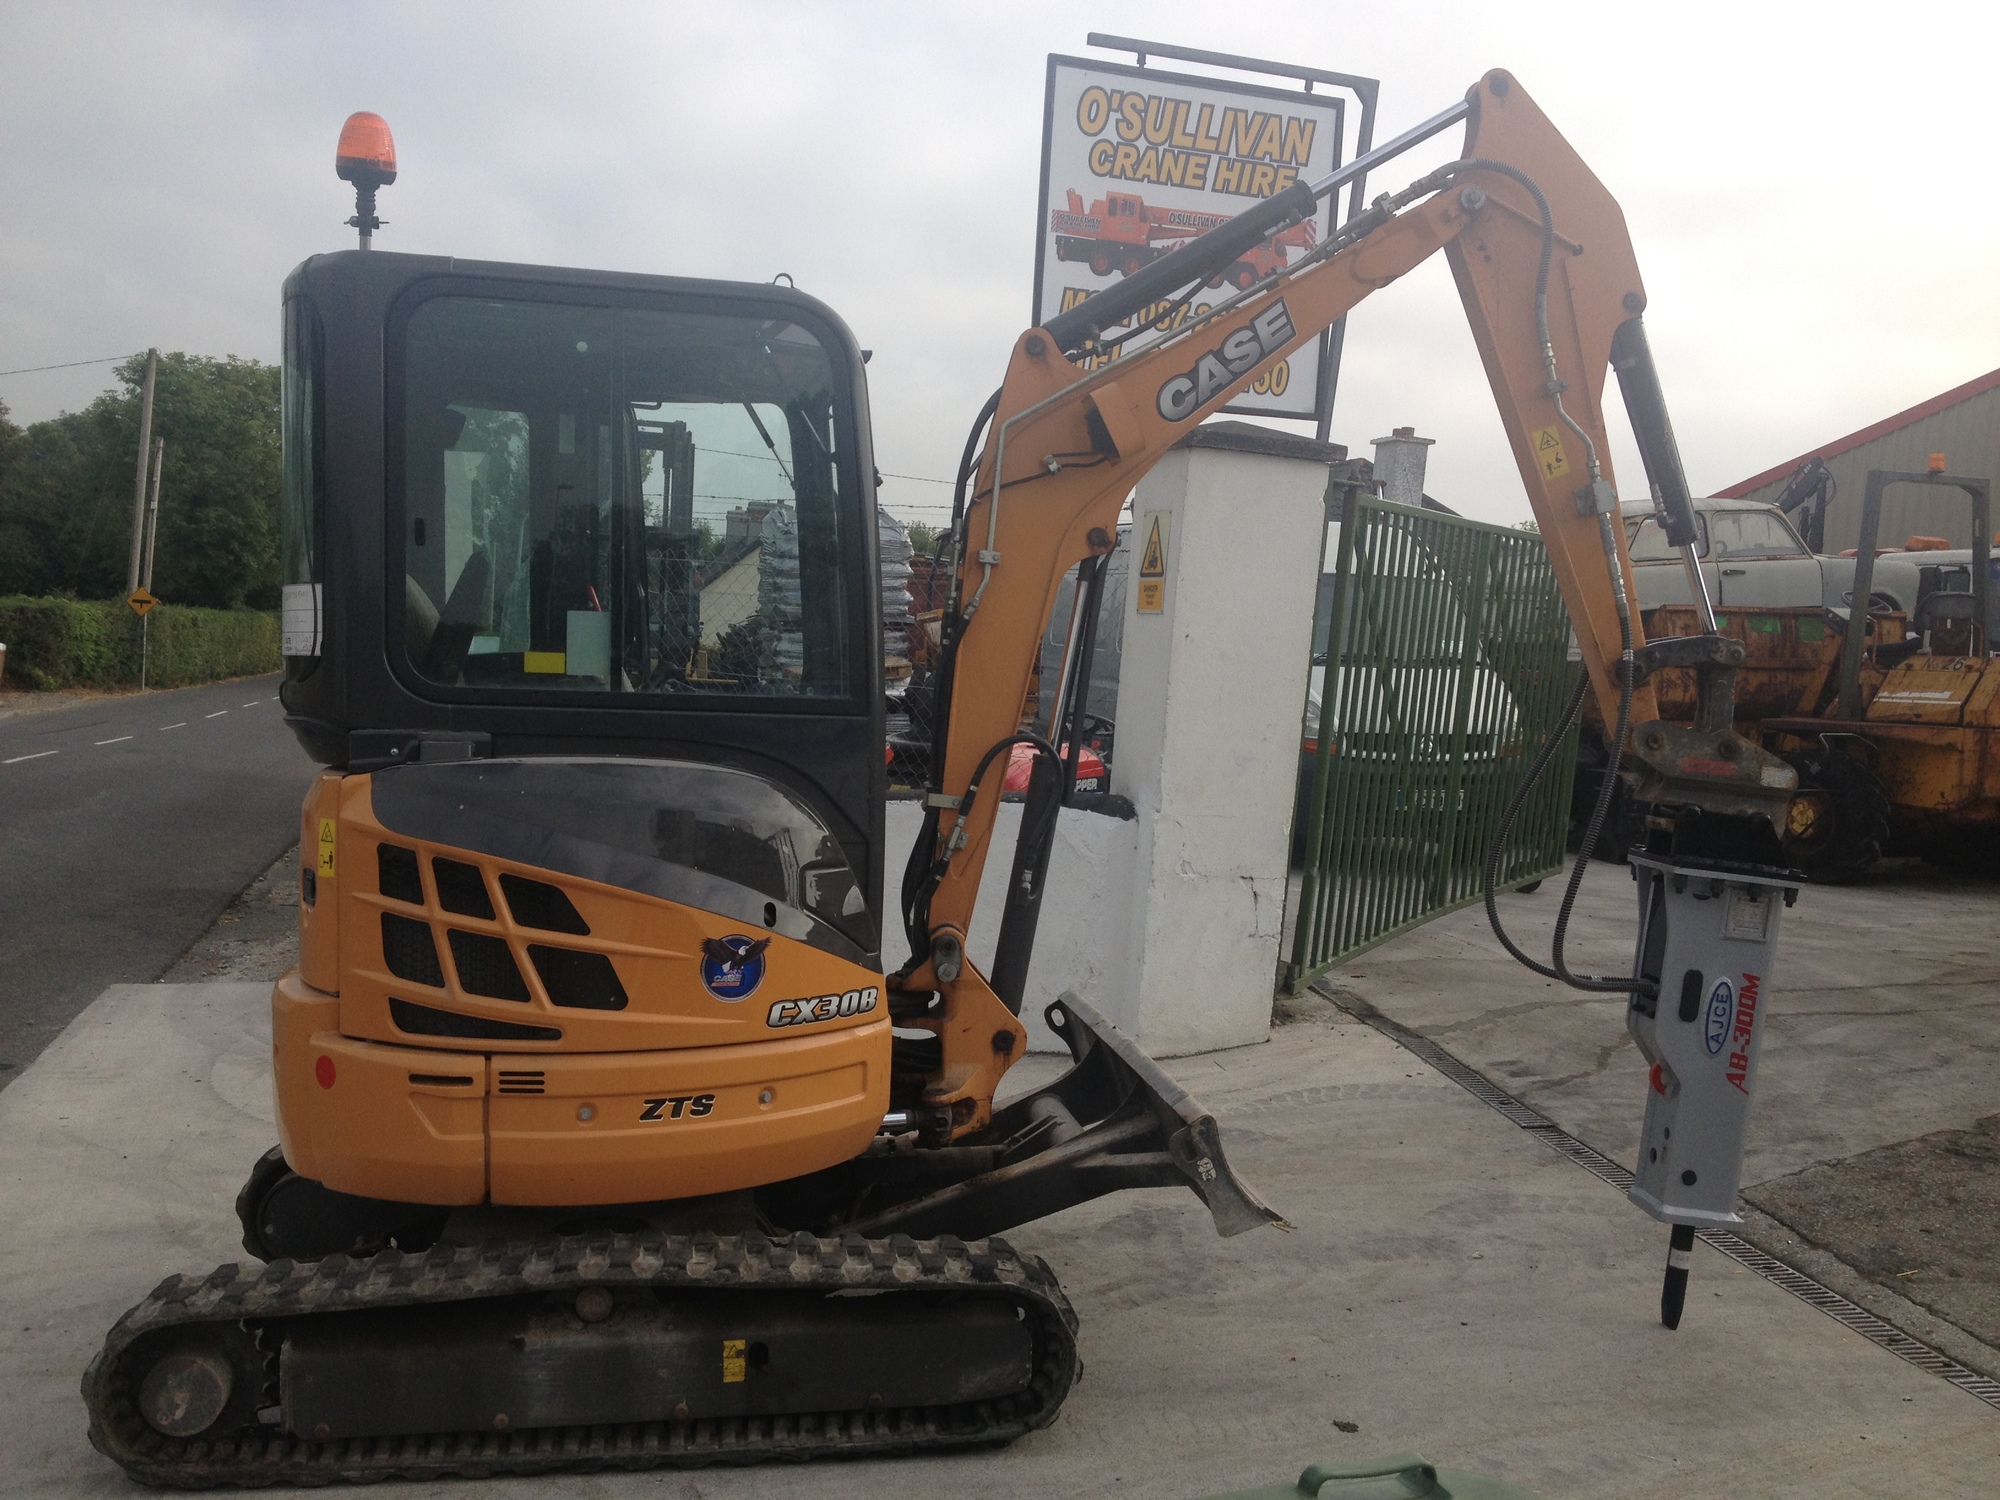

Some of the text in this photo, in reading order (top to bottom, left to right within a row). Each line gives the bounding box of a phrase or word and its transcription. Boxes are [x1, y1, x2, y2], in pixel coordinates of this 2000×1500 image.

[1077, 86, 1317, 167] O'SULLIVAN
[1088, 139, 1300, 199] CRANE HIRE
[1168, 212, 1216, 228] O'SULLIVAN
[1157, 297, 1297, 422] CASE
[766, 986, 879, 1028] CX30B
[1709, 992, 1729, 1045] AJCE
[1725, 972, 1761, 1096] AB-300M
[639, 1094, 716, 1122] ZTS
